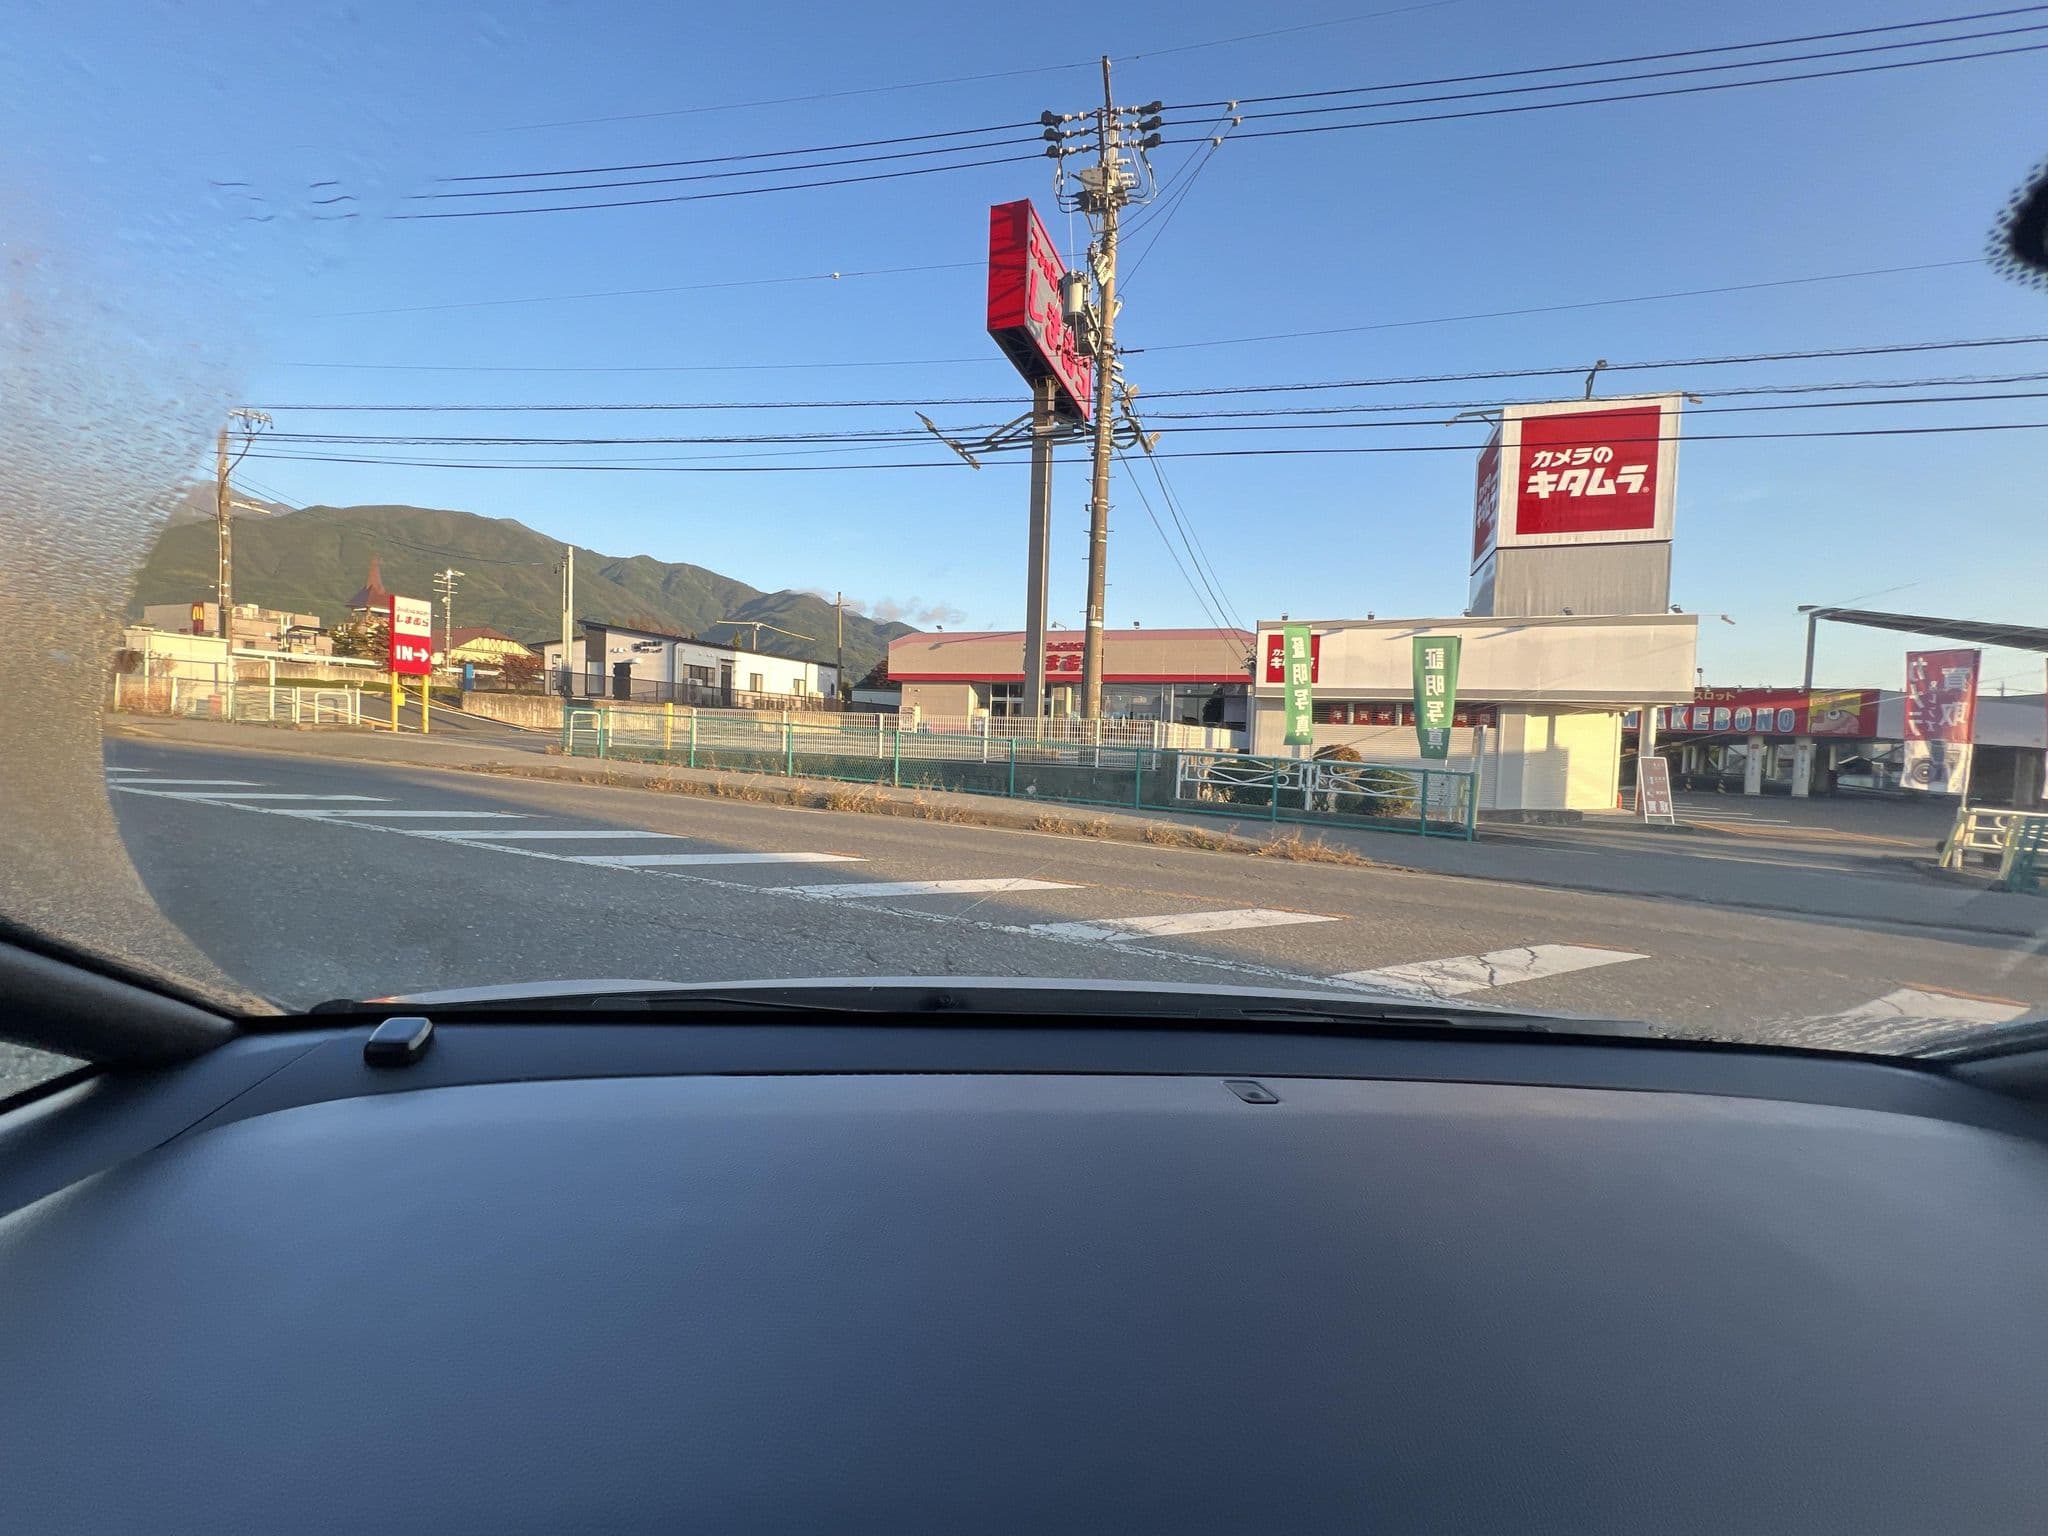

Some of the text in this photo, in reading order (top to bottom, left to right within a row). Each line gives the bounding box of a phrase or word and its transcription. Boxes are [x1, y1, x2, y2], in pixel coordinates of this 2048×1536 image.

[1531, 447, 1614, 468] カメラの
[1527, 464, 1649, 499] キタムラ
[396, 645, 413, 661] IN
